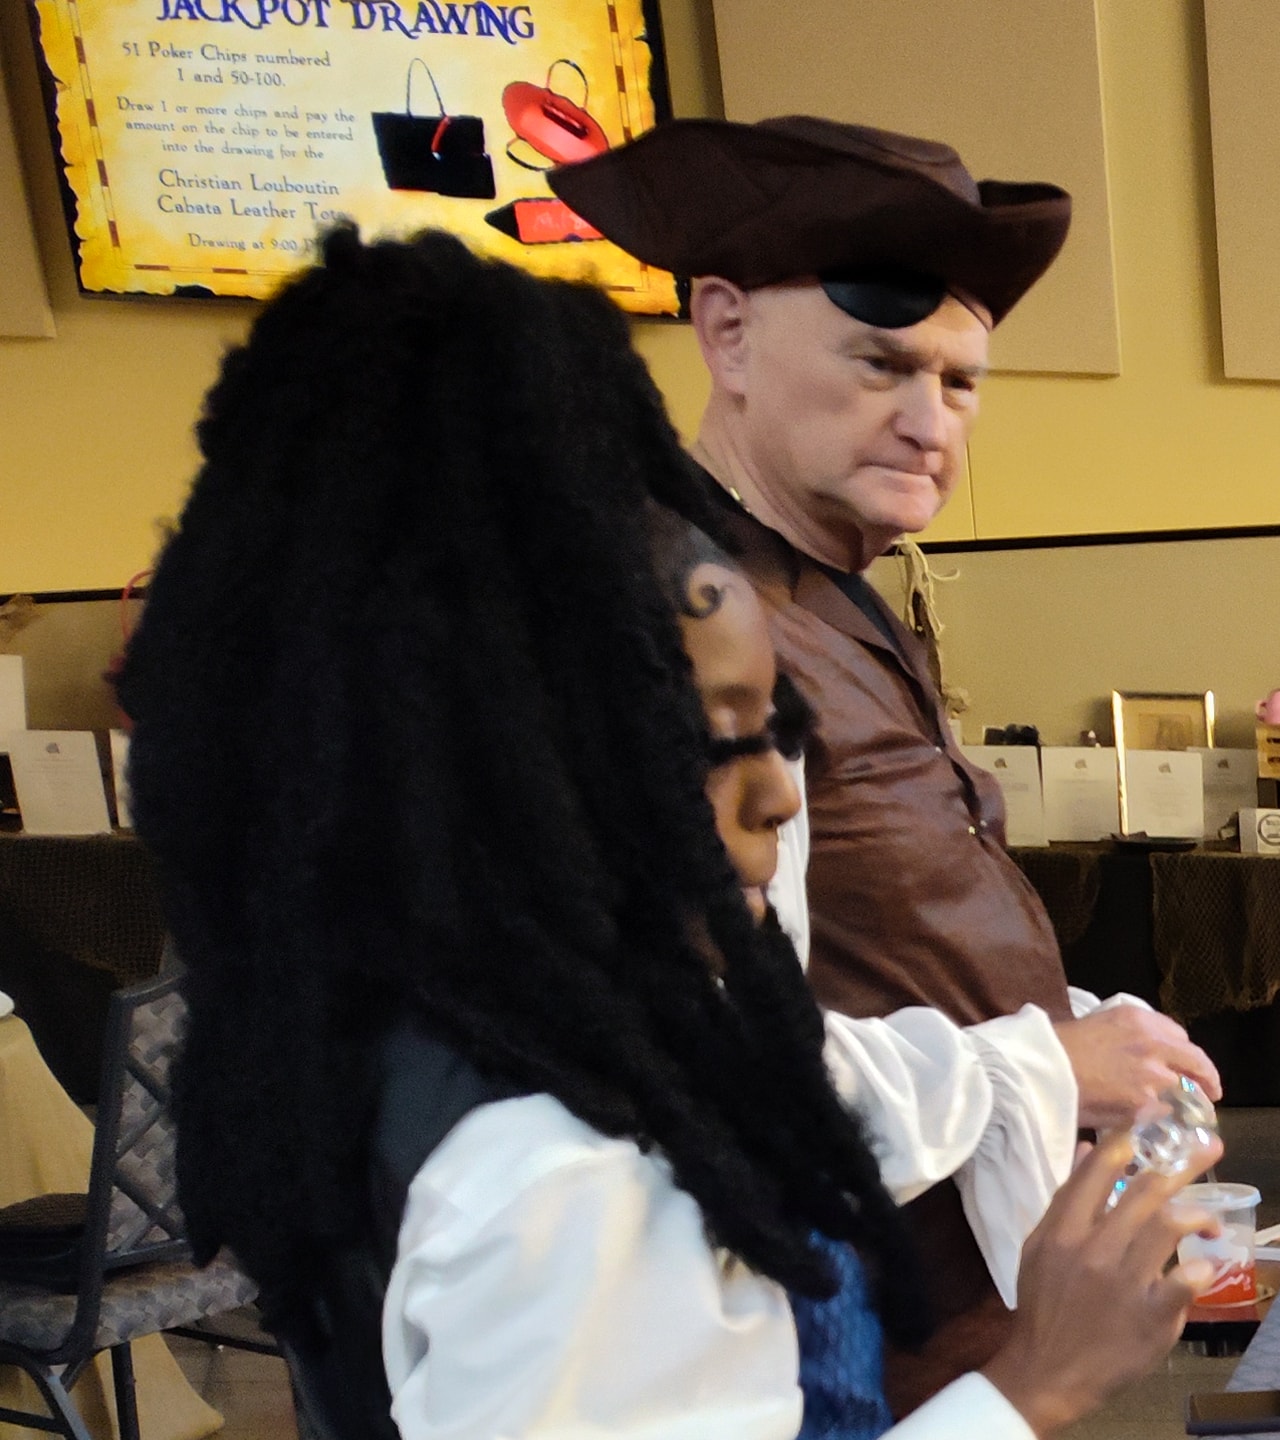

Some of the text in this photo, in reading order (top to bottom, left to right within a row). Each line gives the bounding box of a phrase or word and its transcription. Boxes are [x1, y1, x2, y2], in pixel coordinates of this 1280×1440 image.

[156, 0, 534, 45] JACKPOT DRAWING
[122, 41, 331, 67] 51 Poker Chips numbered
[194, 68, 223, 84] and
[231, 72, 286, 87] 50-100.
[117, 96, 153, 112] Draw
[175, 104, 188, 114] or
[196, 105, 227, 115] more
[234, 102, 268, 120] chips
[274, 105, 300, 120] and
[306, 109, 328, 122] pay
[334, 107, 355, 122] the
[126, 120, 353, 141] amount on the chip to be entered
[162, 140, 324, 160] into the drawing for the
[158, 168, 340, 195] Christian Louboutin
[157, 195, 222, 215] Cabata
[230, 198, 296, 219] Leather
[187, 232, 246, 251] Drawing
[252, 239, 264, 249] at
[271, 239, 297, 251] 9:00
